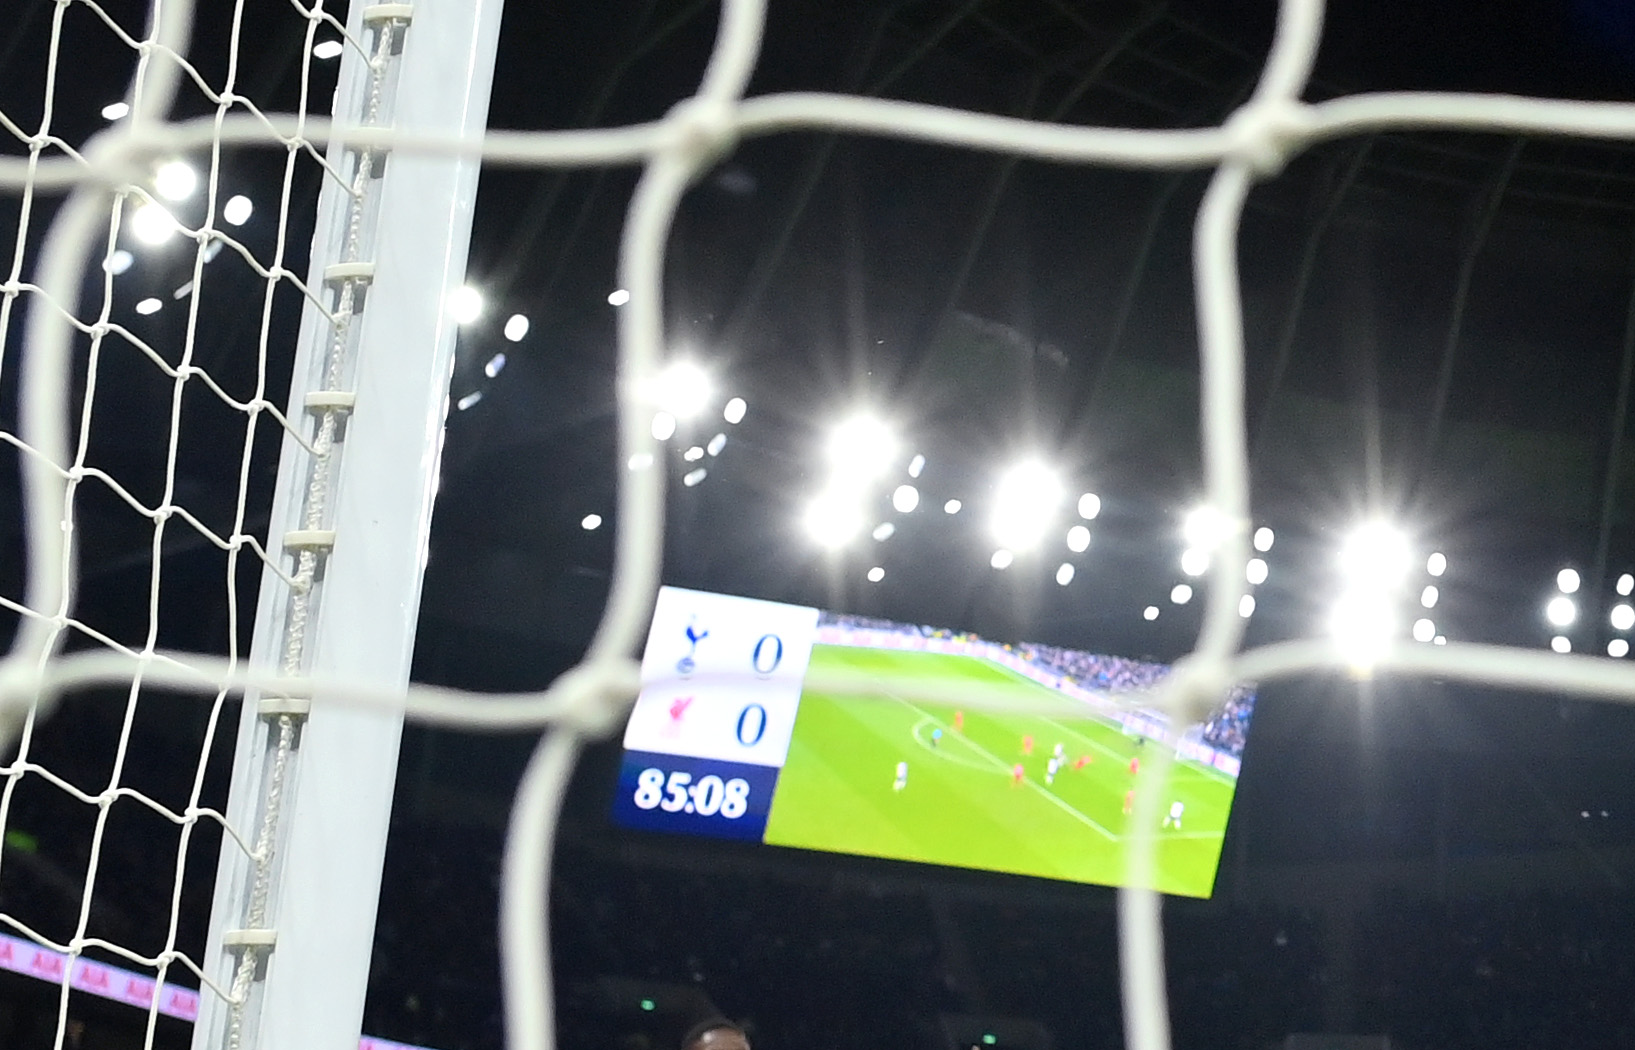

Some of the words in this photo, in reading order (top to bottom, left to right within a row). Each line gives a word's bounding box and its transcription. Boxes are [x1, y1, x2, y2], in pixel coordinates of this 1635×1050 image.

[751, 634, 783, 676] 0
[735, 703, 768, 748] 0
[633, 767, 750, 820] 85:08
